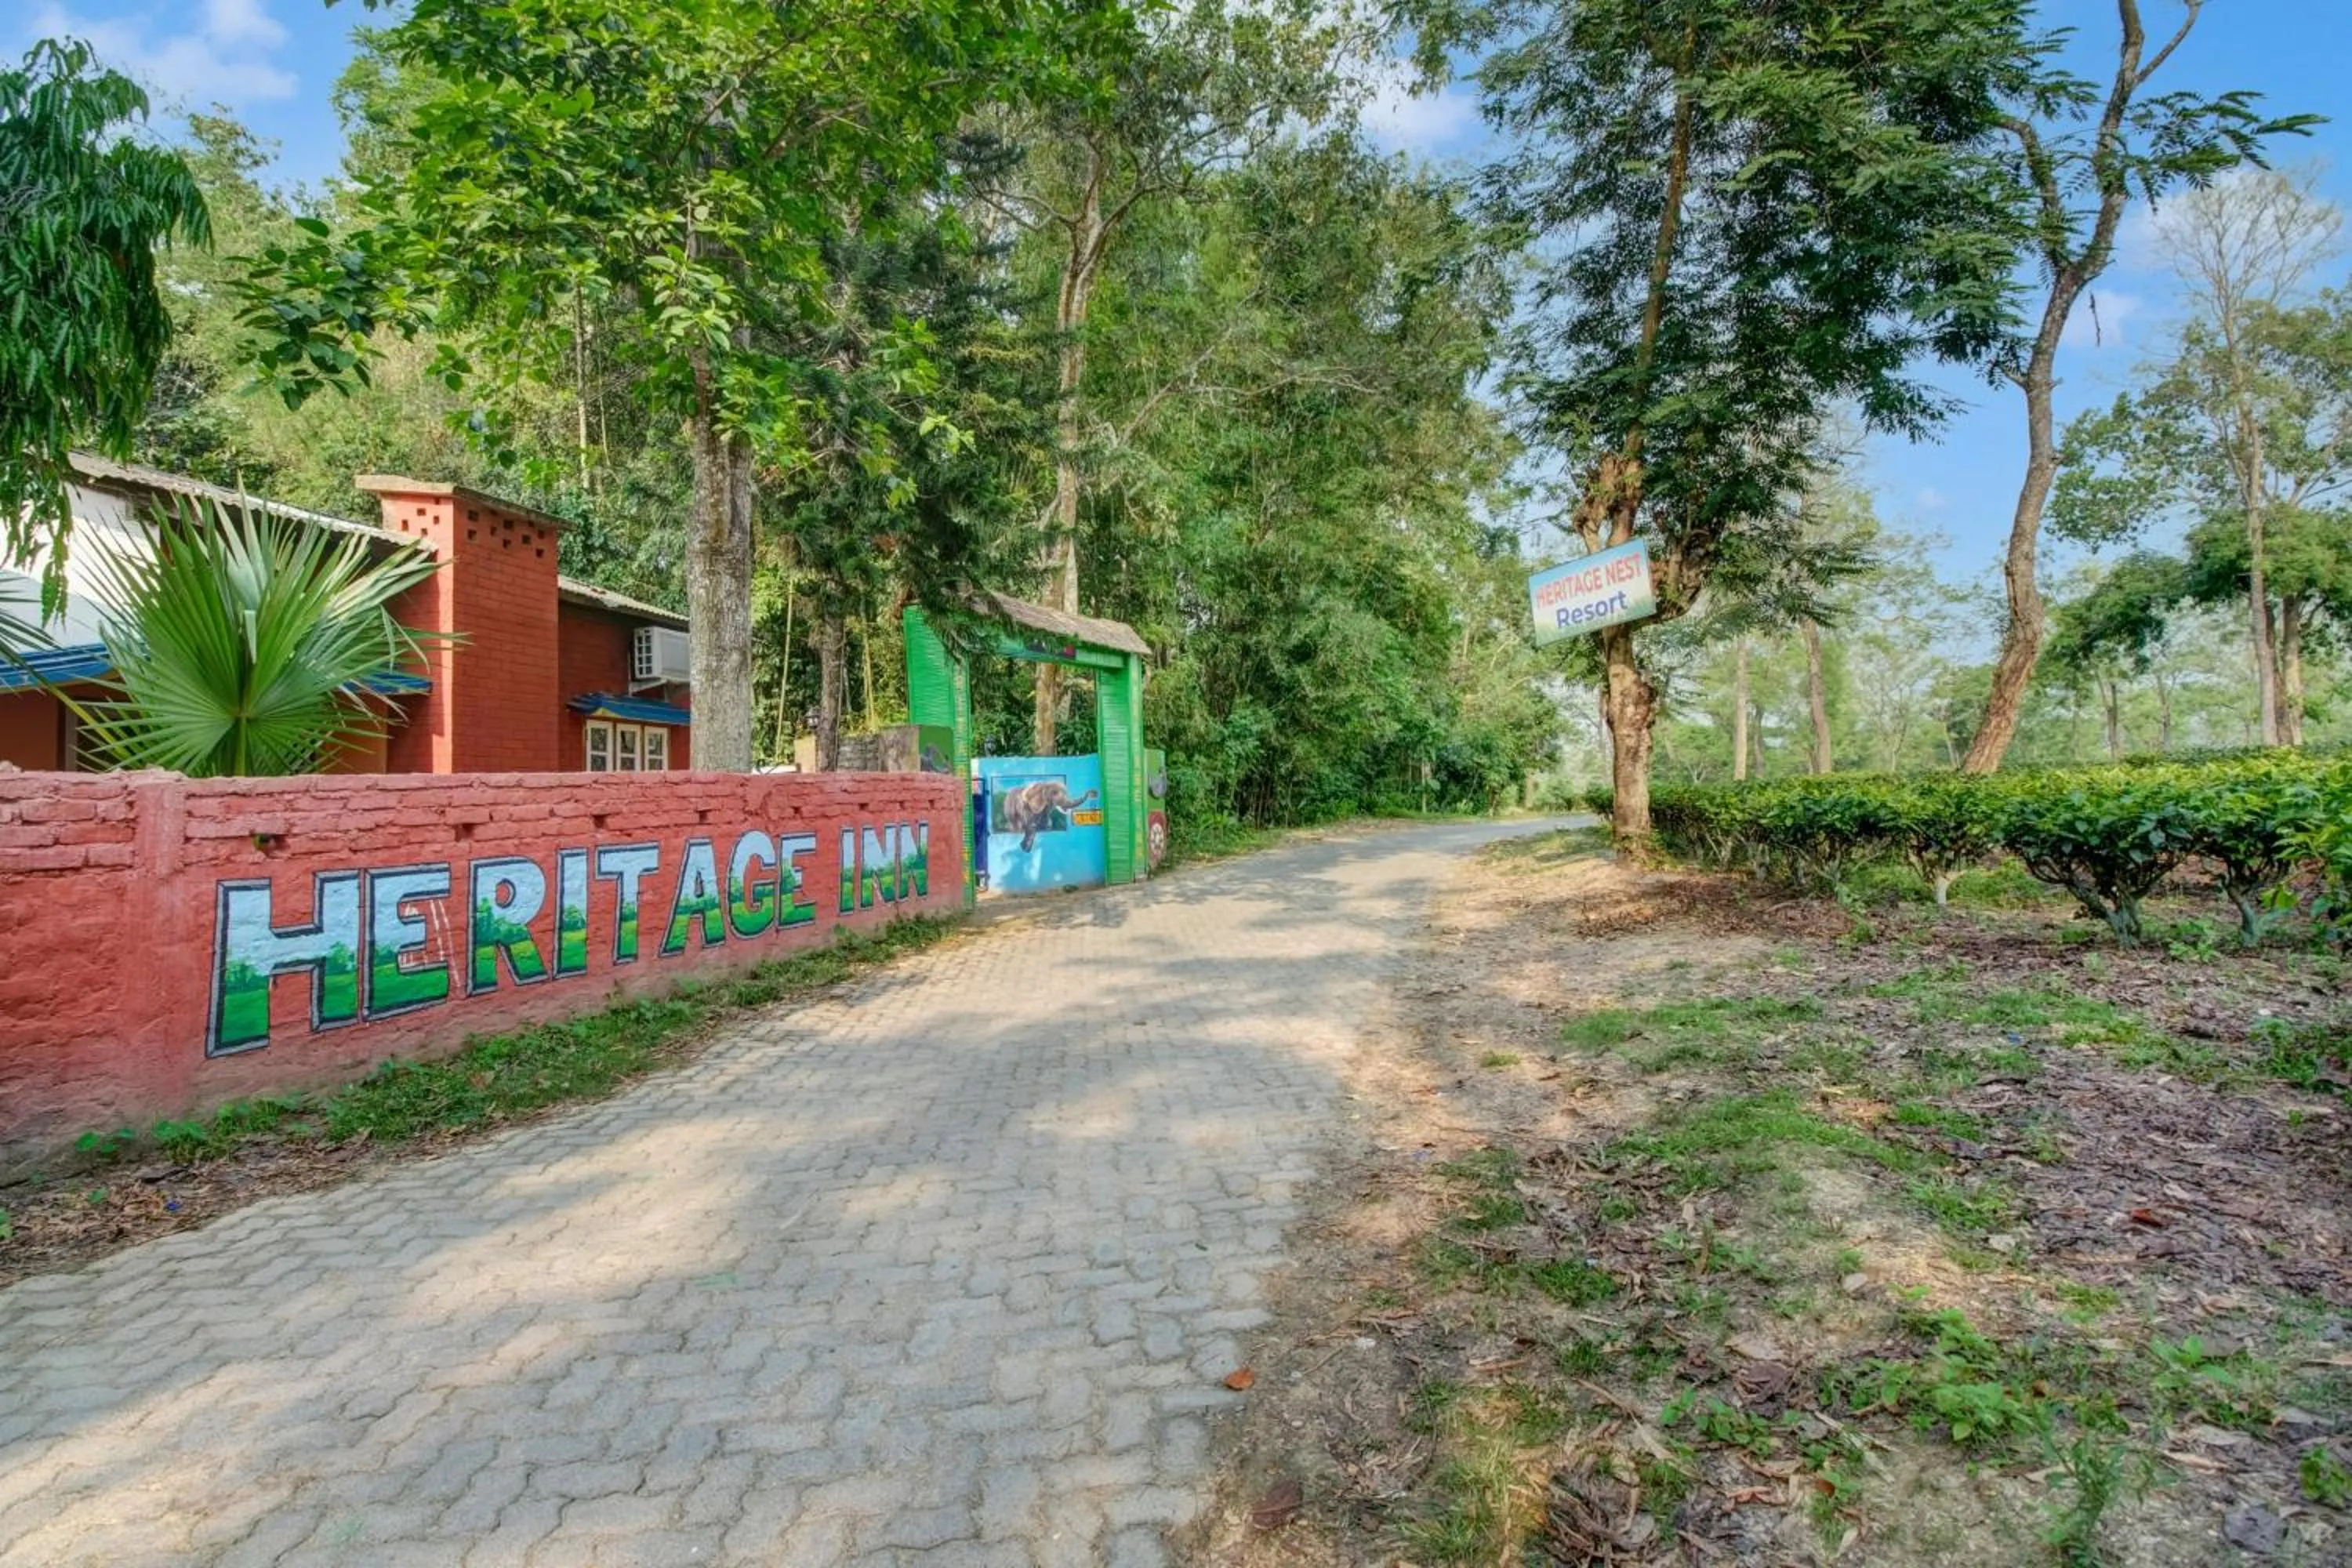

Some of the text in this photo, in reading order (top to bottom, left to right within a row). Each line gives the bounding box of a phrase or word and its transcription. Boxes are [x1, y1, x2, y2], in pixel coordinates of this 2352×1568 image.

[1536, 552, 1642, 609] HERITAGE NEST
[1556, 590, 1628, 628] Resort
[205, 820, 929, 1058] HERITAGE INN
